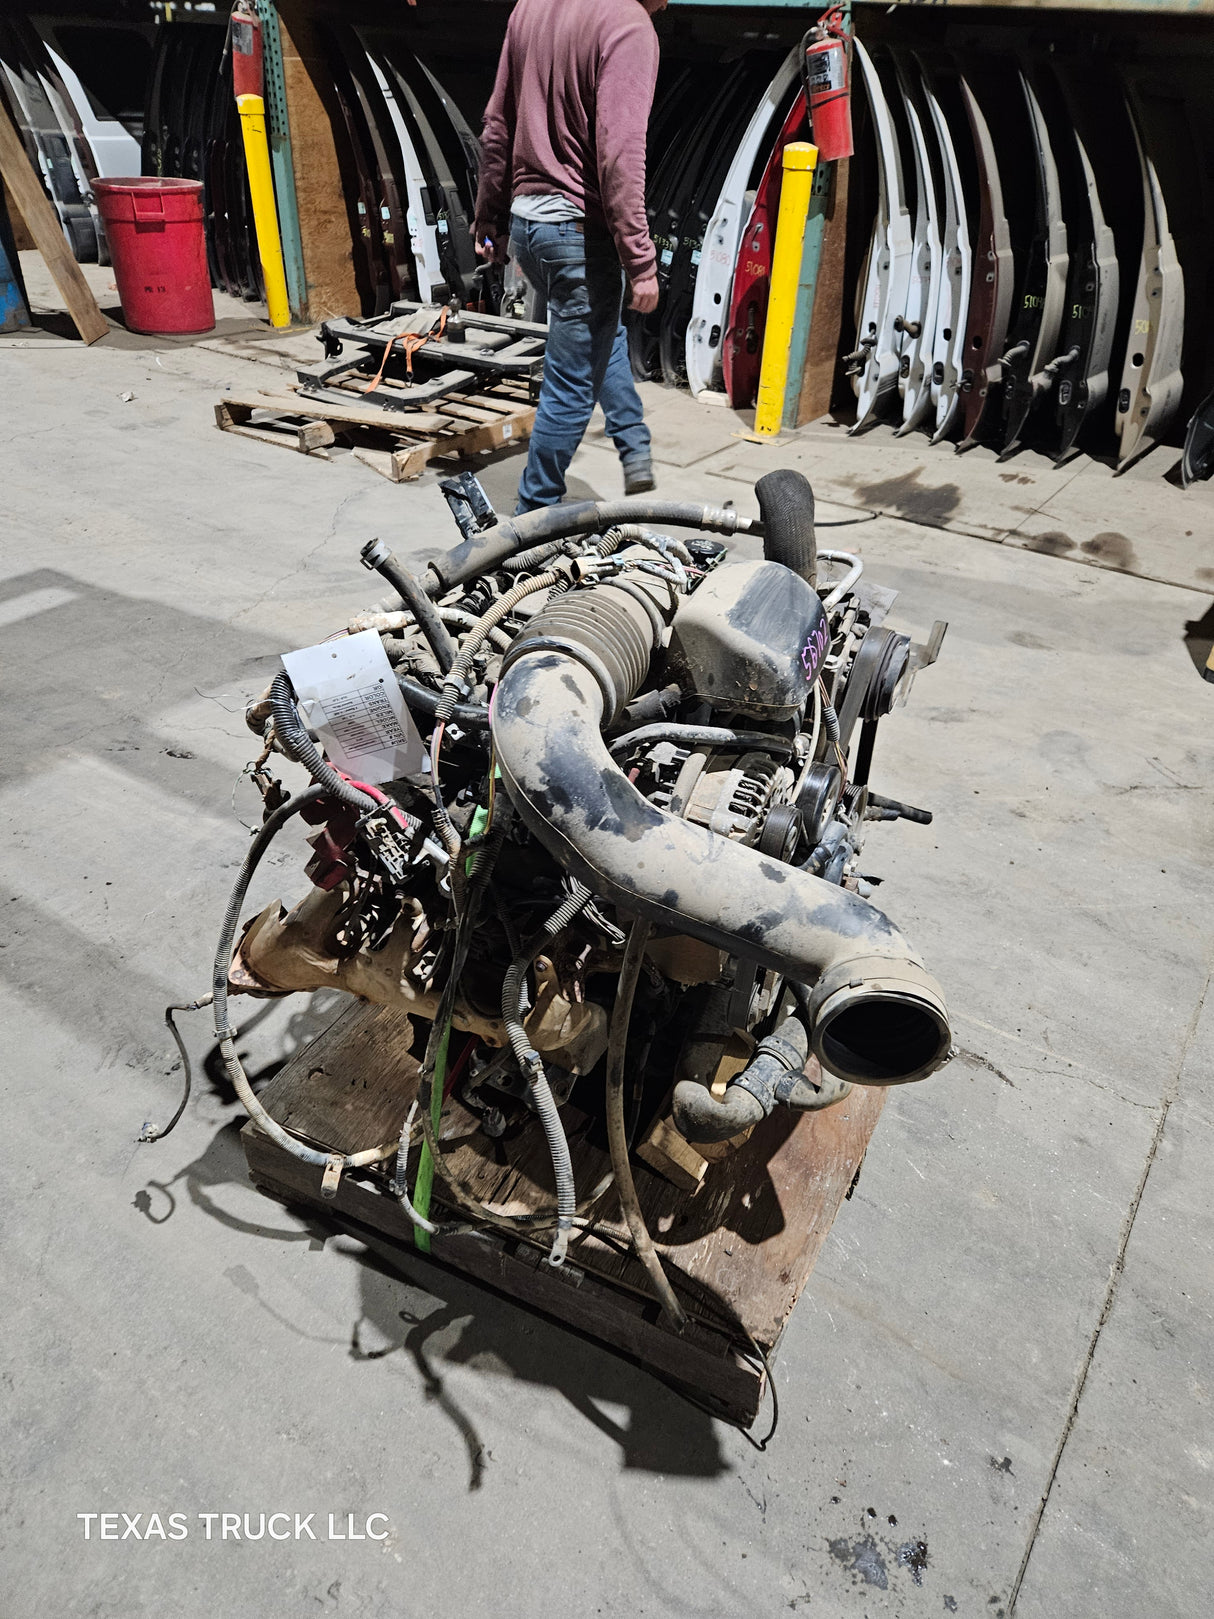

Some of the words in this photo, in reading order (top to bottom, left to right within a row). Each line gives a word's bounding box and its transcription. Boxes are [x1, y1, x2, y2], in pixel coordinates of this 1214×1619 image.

[801, 618, 828, 681] 56702
[364, 691, 385, 700] COLOR
[368, 697, 387, 706] TRANS
[370, 704, 391, 712] ENGINE
